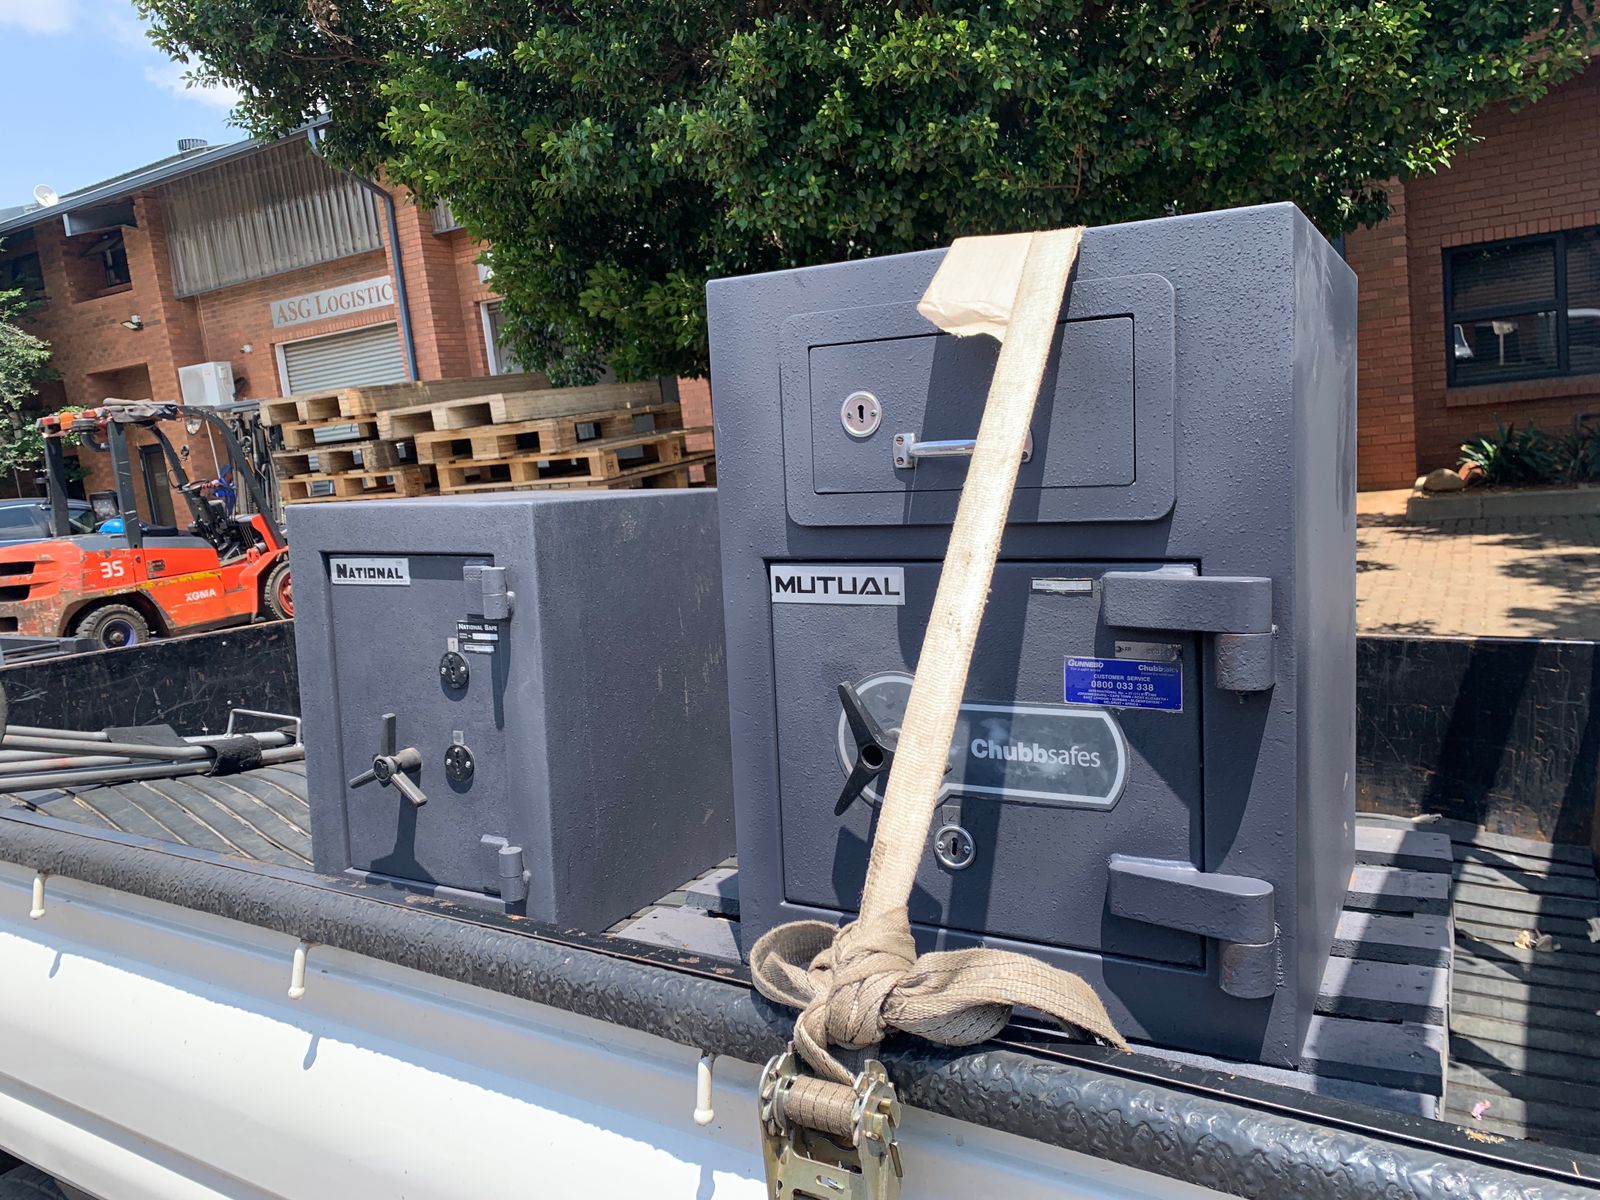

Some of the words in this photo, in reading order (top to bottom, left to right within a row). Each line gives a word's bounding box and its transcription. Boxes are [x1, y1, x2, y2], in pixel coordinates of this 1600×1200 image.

[277, 298, 311, 324] ASG
[100, 560, 125, 579] 35
[336, 563, 404, 579] NATIONAL
[775, 576, 900, 596] MUTUAL
[1068, 659, 1104, 668] GUNNEBO
[1091, 680, 1114, 689] 0800
[1116, 682, 1134, 690] 033
[1136, 683, 1154, 691] 338
[971, 738, 1101, 768] Chubbsafes
